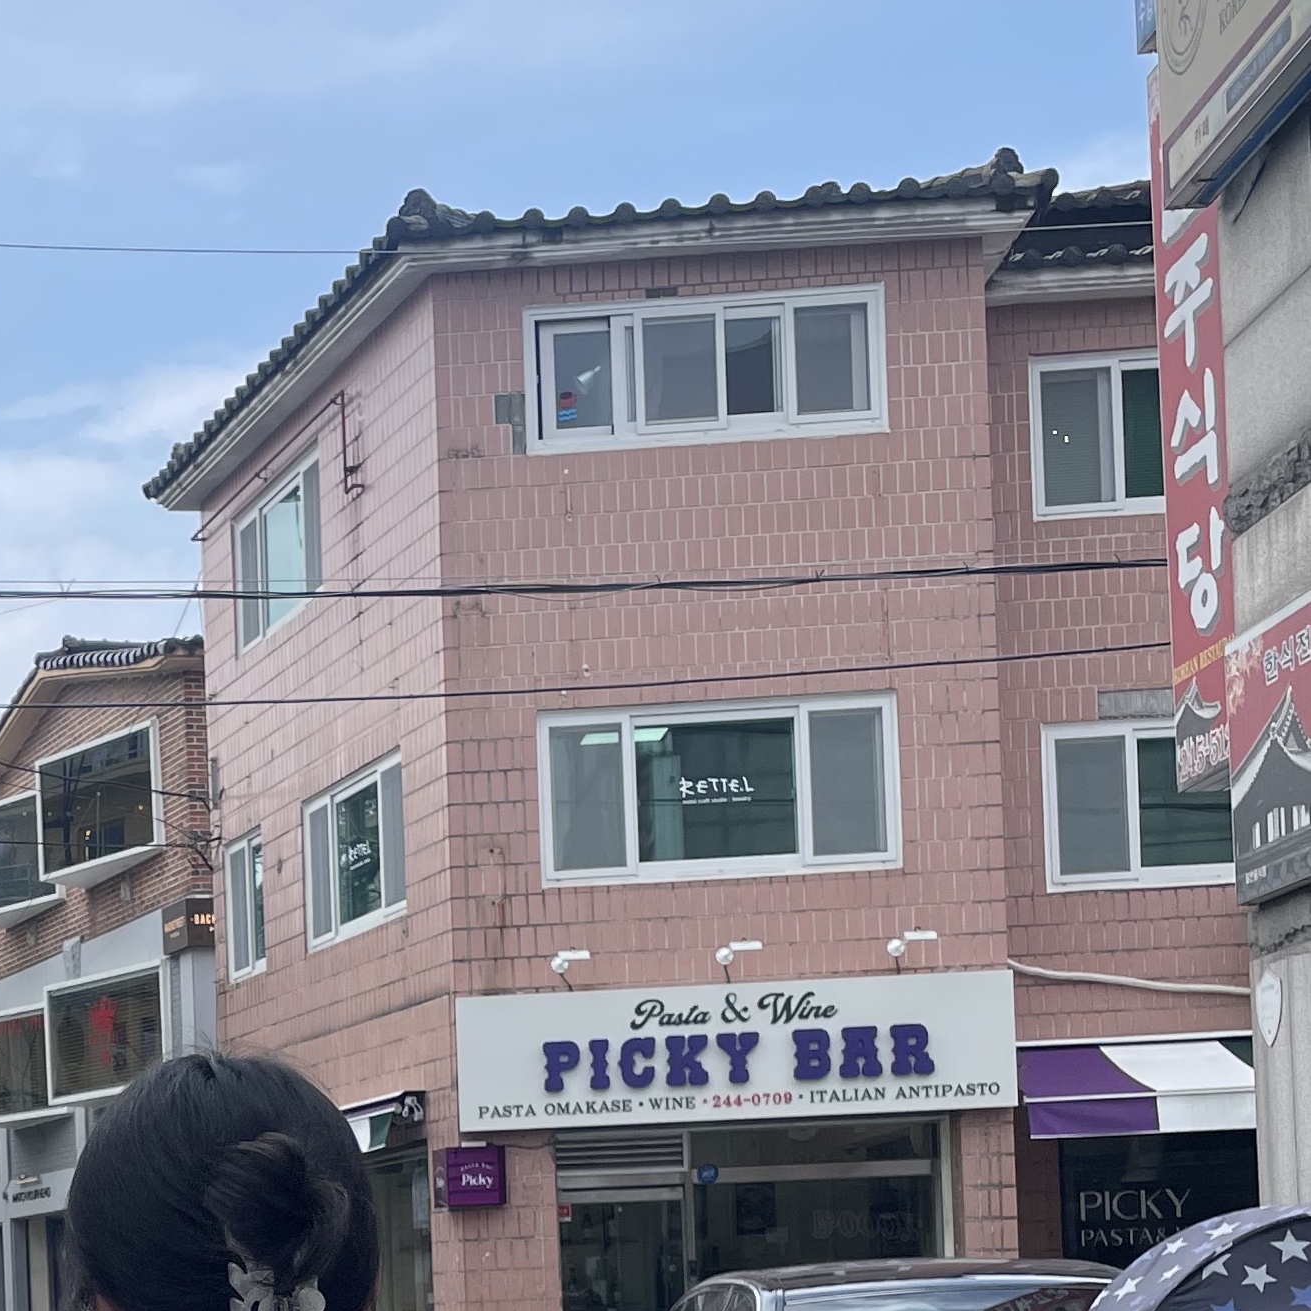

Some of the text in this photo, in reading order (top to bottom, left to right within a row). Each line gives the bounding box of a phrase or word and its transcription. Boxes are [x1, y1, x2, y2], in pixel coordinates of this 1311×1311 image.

[1162, 209, 1224, 630] 주식당
[630, 991, 838, 1030] Pasta & Wine
[542, 1023, 935, 1093] PICKY BAR
[478, 1082, 1001, 1120] PASTA OMAKASE WINE 244-0709 ITALIAN ANTIPASTO
[461, 1173, 494, 1189] Picky
[1079, 1188, 1191, 1222] PICKY
